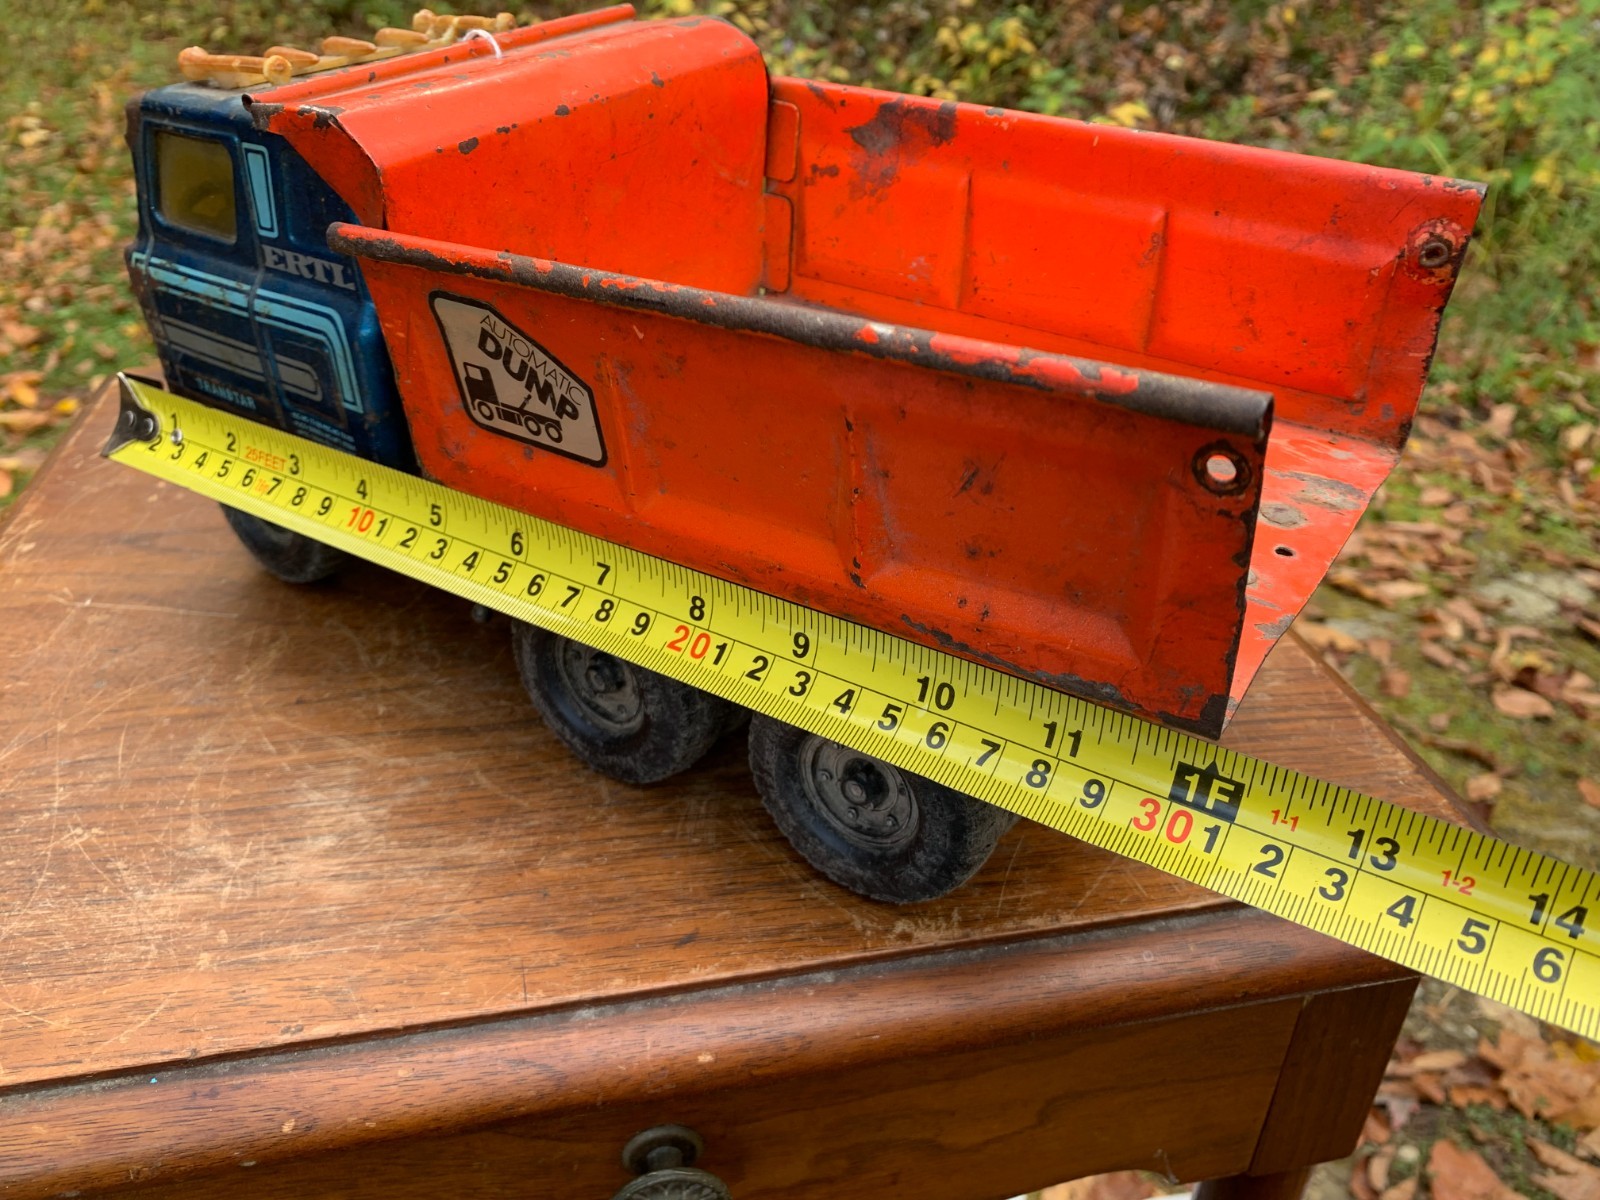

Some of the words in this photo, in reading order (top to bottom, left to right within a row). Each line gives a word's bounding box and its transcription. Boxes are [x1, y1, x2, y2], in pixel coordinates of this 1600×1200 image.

[262, 245, 355, 291] ERTL
[478, 327, 580, 421] DUMP
[480, 314, 585, 406] AUTOMATIC
[149, 435, 162, 451] 2
[172, 441, 185, 460] 3
[195, 452, 208, 468] 4
[218, 460, 232, 477] 5
[242, 469, 256, 486] 6
[266, 478, 282, 495] 7
[292, 487, 307, 506] 8
[318, 497, 332, 516] 9
[348, 506, 374, 532] 10
[376, 518, 388, 537] 1
[400, 528, 417, 548] 2
[431, 538, 448, 560] 3
[462, 551, 479, 572] 4
[494, 562, 512, 583] 5
[527, 574, 545, 596] 6
[560, 586, 580, 608] 7
[594, 599, 614, 622] 8
[630, 612, 650, 636] 9
[667, 624, 711, 659] 20
[714, 642, 728, 666] 1
[746, 655, 768, 682] 2
[789, 671, 810, 696] 3
[833, 689, 856, 714] 4
[878, 703, 902, 730] 5
[926, 722, 949, 749] 6
[976, 738, 1000, 766] 7
[1026, 759, 1052, 788] 8
[1080, 778, 1105, 808] 9
[1133, 798, 1194, 844] 30
[1204, 824, 1220, 854] 1
[1253, 844, 1284, 878] 2
[1318, 868, 1348, 901] 3
[1386, 894, 1416, 928] 4
[1457, 918, 1490, 954] 5
[1533, 947, 1564, 983] 6
[171, 413, 177, 430] 1
[226, 432, 236, 452] 2
[290, 454, 299, 475] 3
[356, 480, 368, 499] 4
[430, 504, 442, 526] 5
[511, 532, 523, 556] 6
[596, 562, 610, 586] 7
[689, 596, 706, 621] 8
[792, 632, 810, 658] 9
[917, 676, 955, 710] 10
[1043, 721, 1083, 758] 11
[1184, 773, 1235, 810] 1F
[1347, 828, 1400, 871] 13
[1528, 892, 1589, 940] 14
[1271, 809, 1299, 832] 1-1
[1442, 870, 1476, 896] 1-2
